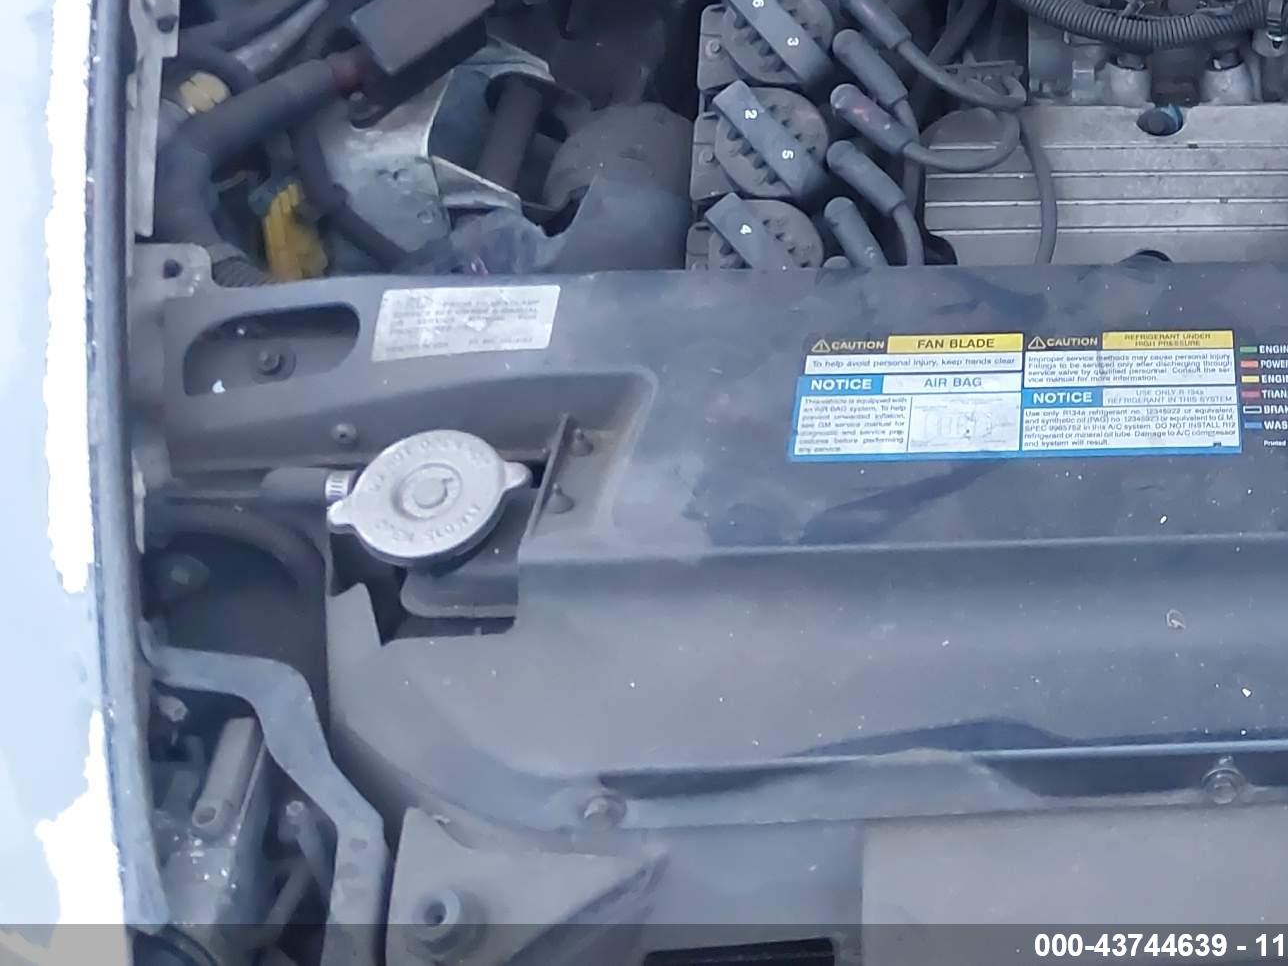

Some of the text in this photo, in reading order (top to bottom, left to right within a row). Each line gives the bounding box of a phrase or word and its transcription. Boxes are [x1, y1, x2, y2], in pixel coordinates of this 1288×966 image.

[787, 37, 799, 46] 3
[745, 109, 757, 120] 2
[782, 149, 794, 159] 5
[740, 224, 752, 235] 4
[1046, 337, 1098, 347] CAUTION
[1124, 333, 1180, 341] REFRIGERANT
[831, 338, 995, 351] CAUTION FAN BLADE
[825, 359, 844, 369] help
[846, 359, 870, 367] avoid
[872, 359, 911, 369] personal
[913, 358, 938, 368] injury,
[941, 358, 962, 367] keep
[965, 357, 991, 365] hands
[1028, 355, 1064, 364] Improper
[1132, 354, 1148, 363] may
[1175, 353, 1208, 362] personal
[1203, 360, 1232, 368] through
[1081, 369, 1091, 377] by
[810, 377, 982, 391] NOTICE AIR BAG
[1033, 391, 1093, 404] NOTICE
[1043, 410, 1059, 418] only
[1089, 409, 1128, 418] refrigerant
[1135, 430, 1166, 439] Damage
[1042, 440, 1069, 448] system
